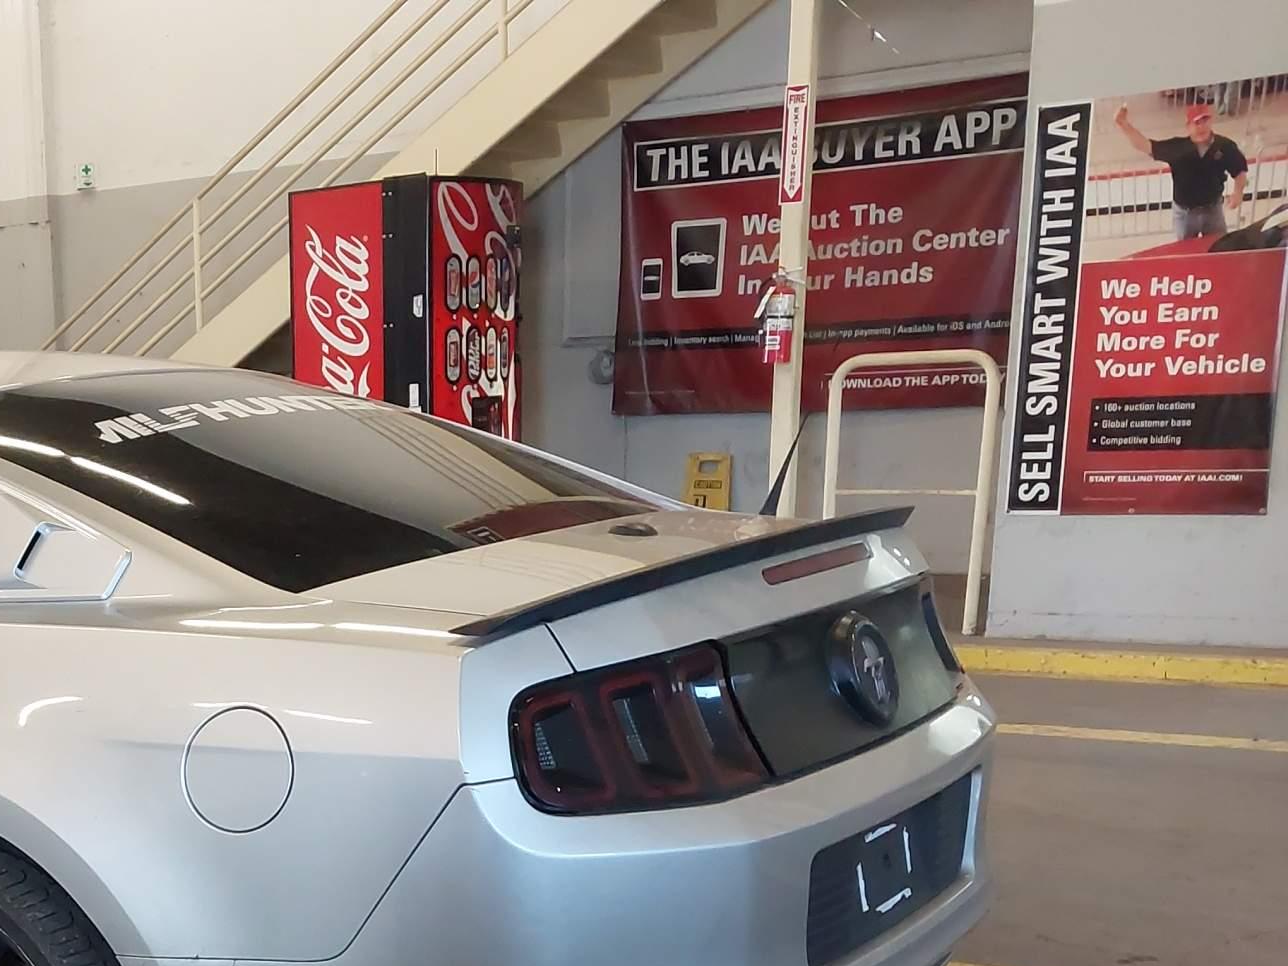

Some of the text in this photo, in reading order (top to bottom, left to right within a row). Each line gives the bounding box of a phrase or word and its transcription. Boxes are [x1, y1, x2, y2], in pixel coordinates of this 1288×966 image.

[789, 93, 806, 104] FIRE
[646, 144, 710, 181] THE
[720, 136, 781, 175] IAA
[934, 108, 1017, 153] APP
[788, 107, 800, 191] EXTINGUISHER
[742, 203, 903, 236] We ut The
[912, 227, 1010, 252] Center
[737, 262, 934, 295] In ur Hands
[1101, 275, 1212, 299] We Help
[305, 223, 370, 397] a-Cola
[1018, 112, 1081, 502] SELL SMART WITH IAA
[1099, 303, 1219, 325] You Earn
[966, 321, 982, 329] and
[983, 319, 1010, 328] Andro
[734, 333, 761, 346] Manag
[1096, 329, 1219, 352] More For
[1095, 353, 1266, 378] Your Vehicle
[828, 374, 902, 389] OWNLOAD
[903, 375, 928, 387] THE
[931, 373, 960, 386] APP
[1124, 402, 1155, 411] auction
[1156, 401, 1196, 410] locations
[1101, 418, 1192, 428] Global customer base
[1100, 434, 1181, 446] Competitive bidding
[1089, 475, 1115, 483] START
[1117, 475, 1153, 483] SELLING
[1154, 474, 1182, 482] TODAY
[1184, 474, 1195, 482] AT
